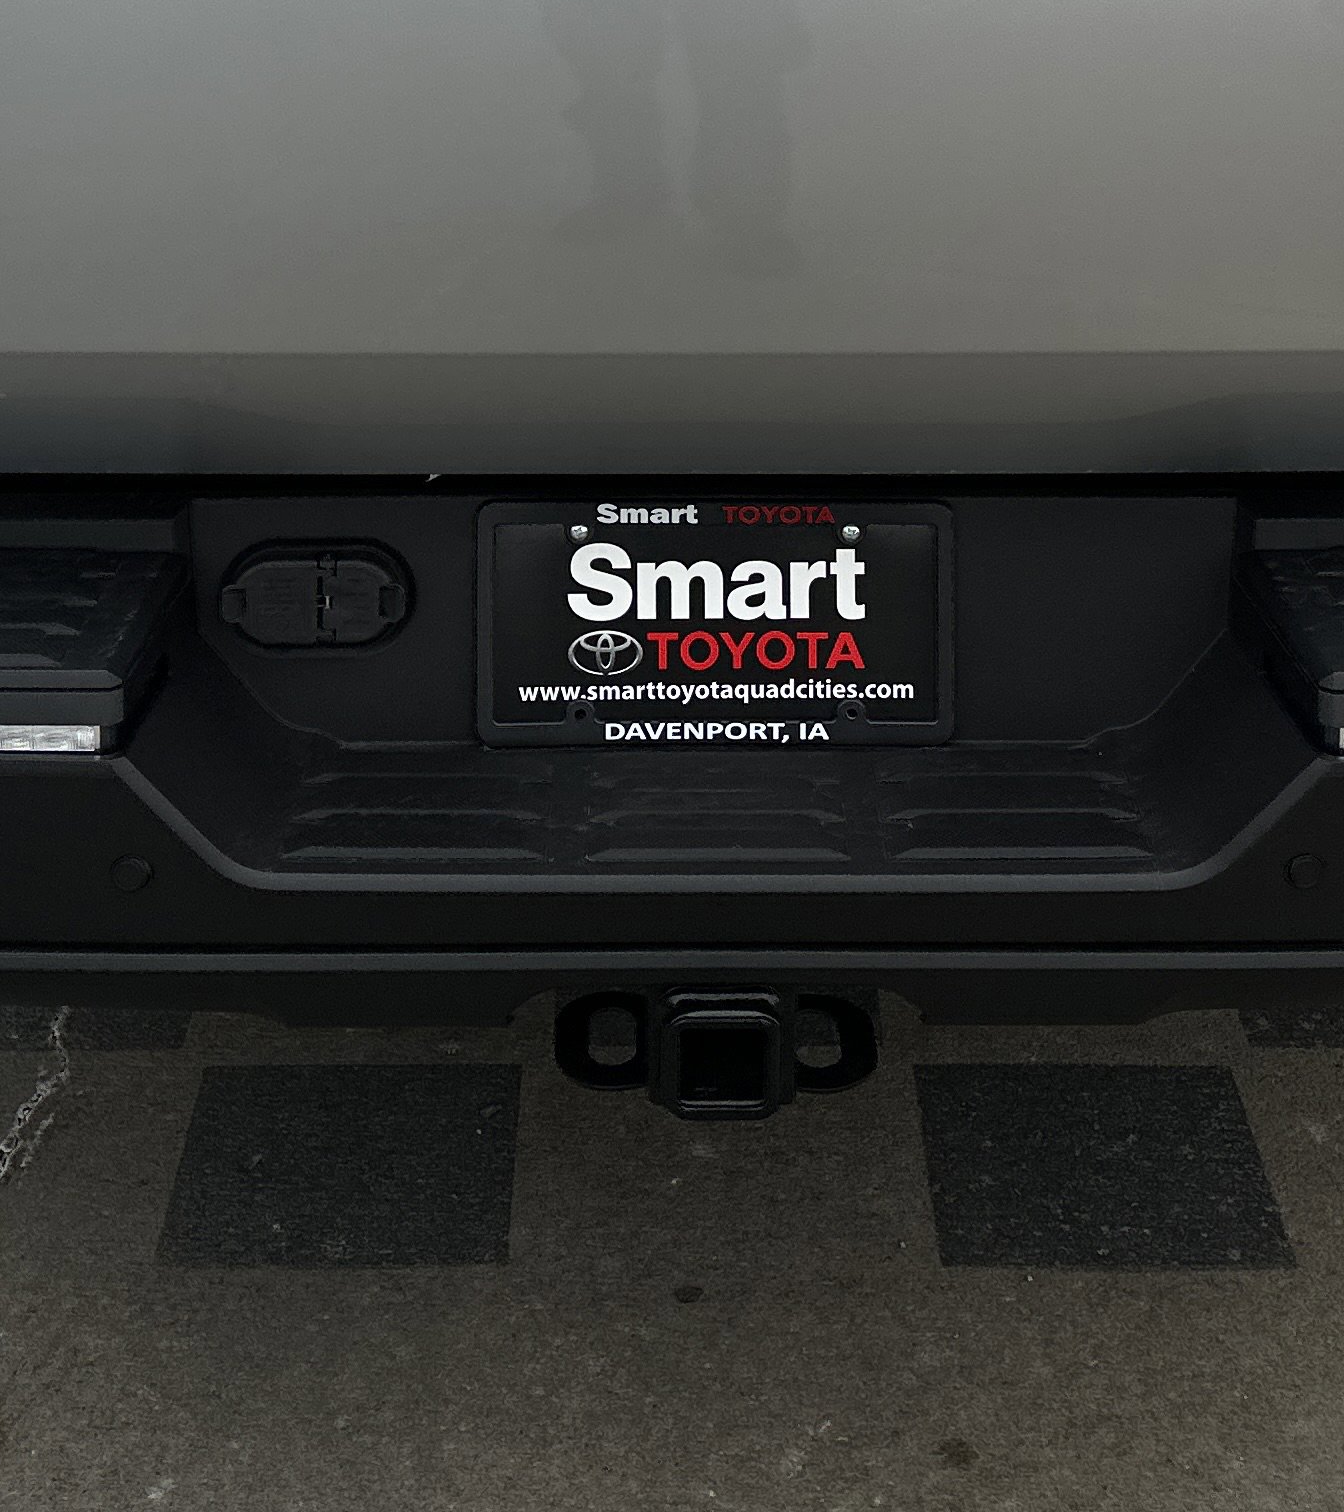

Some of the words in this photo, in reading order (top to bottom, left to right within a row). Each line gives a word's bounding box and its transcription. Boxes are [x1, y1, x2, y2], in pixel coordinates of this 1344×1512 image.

[596, 503, 699, 525] Smart
[722, 505, 836, 525] TOYOTA
[567, 542, 866, 622] Smart
[646, 631, 865, 670] TOYOTA
[518, 678, 915, 705] www.smarttoyotaquadcities.com
[605, 722, 791, 743] DAVENPORT,
[799, 722, 830, 741] IA
